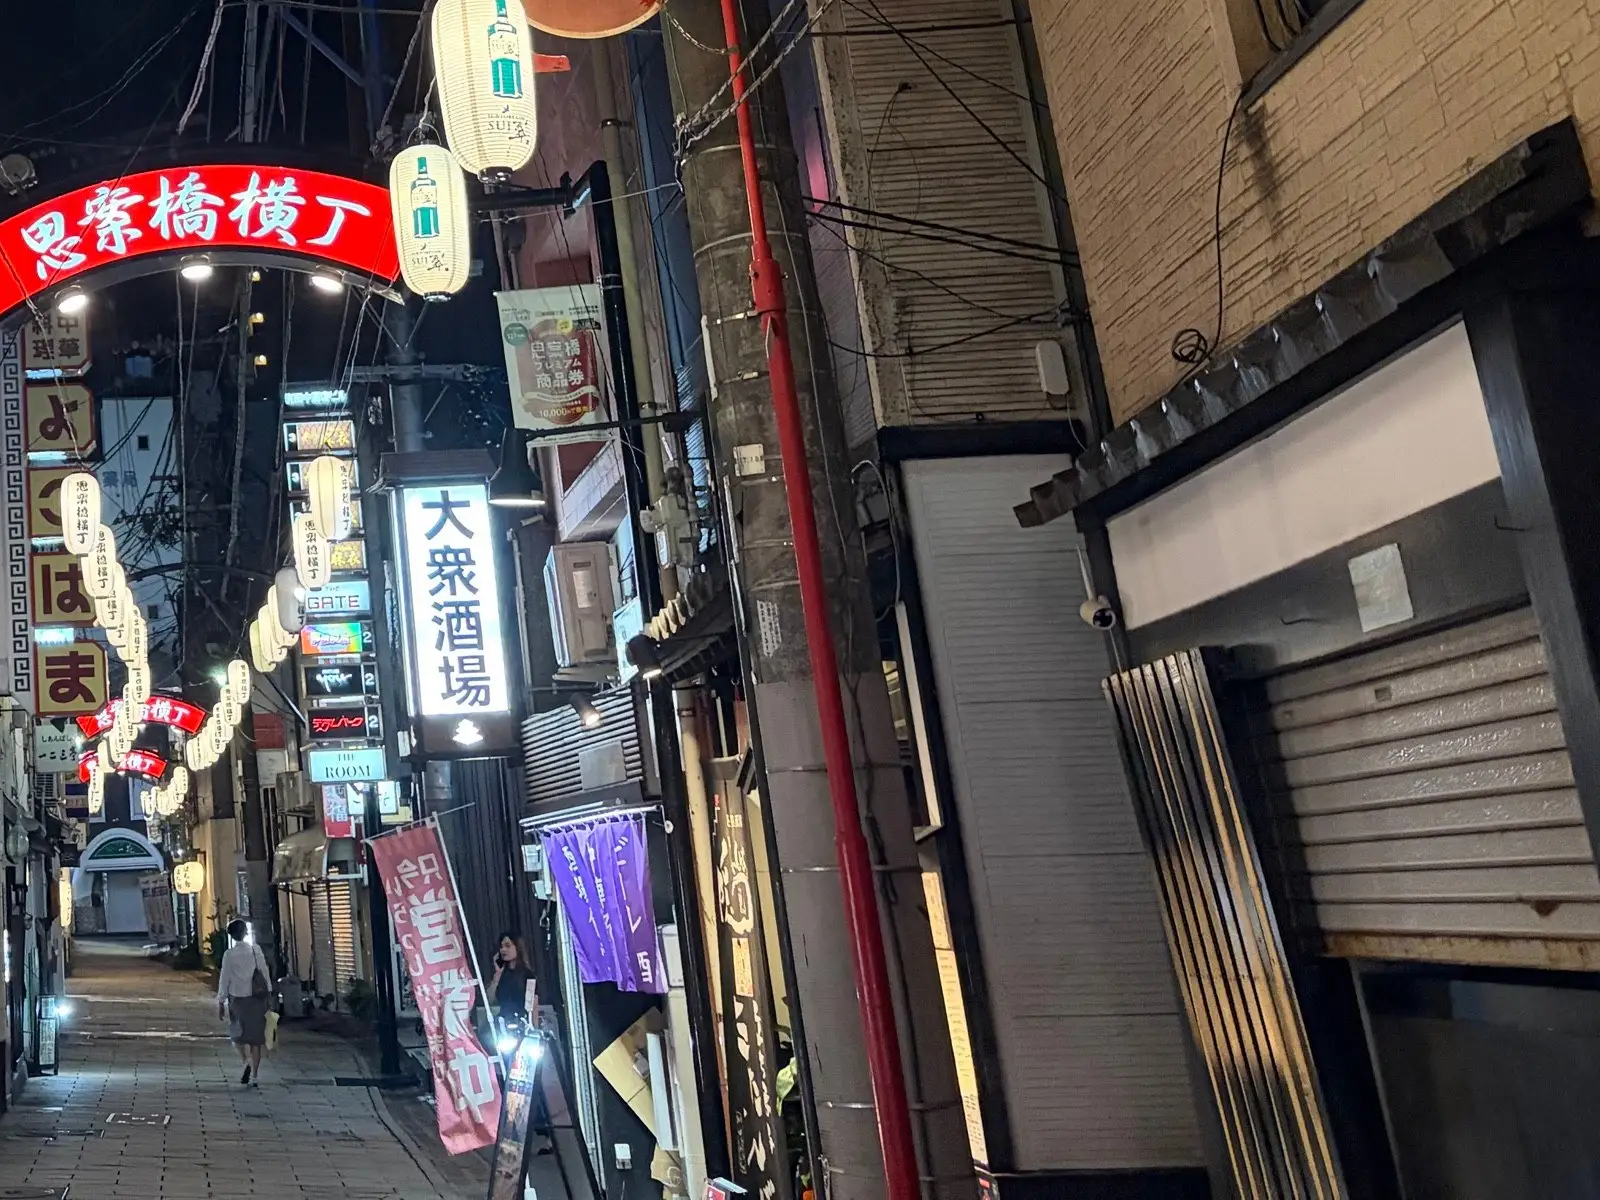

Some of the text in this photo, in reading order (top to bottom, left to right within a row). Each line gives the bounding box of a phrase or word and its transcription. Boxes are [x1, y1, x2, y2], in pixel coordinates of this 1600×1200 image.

[20, 171, 371, 277] 思案橋横丁
[536, 369, 584, 389] 商品券
[76, 480, 88, 544] 思案橋横丁
[304, 519, 319, 580] 思案橋横丁
[307, 594, 360, 610] GATE
[421, 489, 491, 707] 大衆酒場
[324, 766, 371, 779] ROOM
[411, 886, 495, 1124] 営業中
